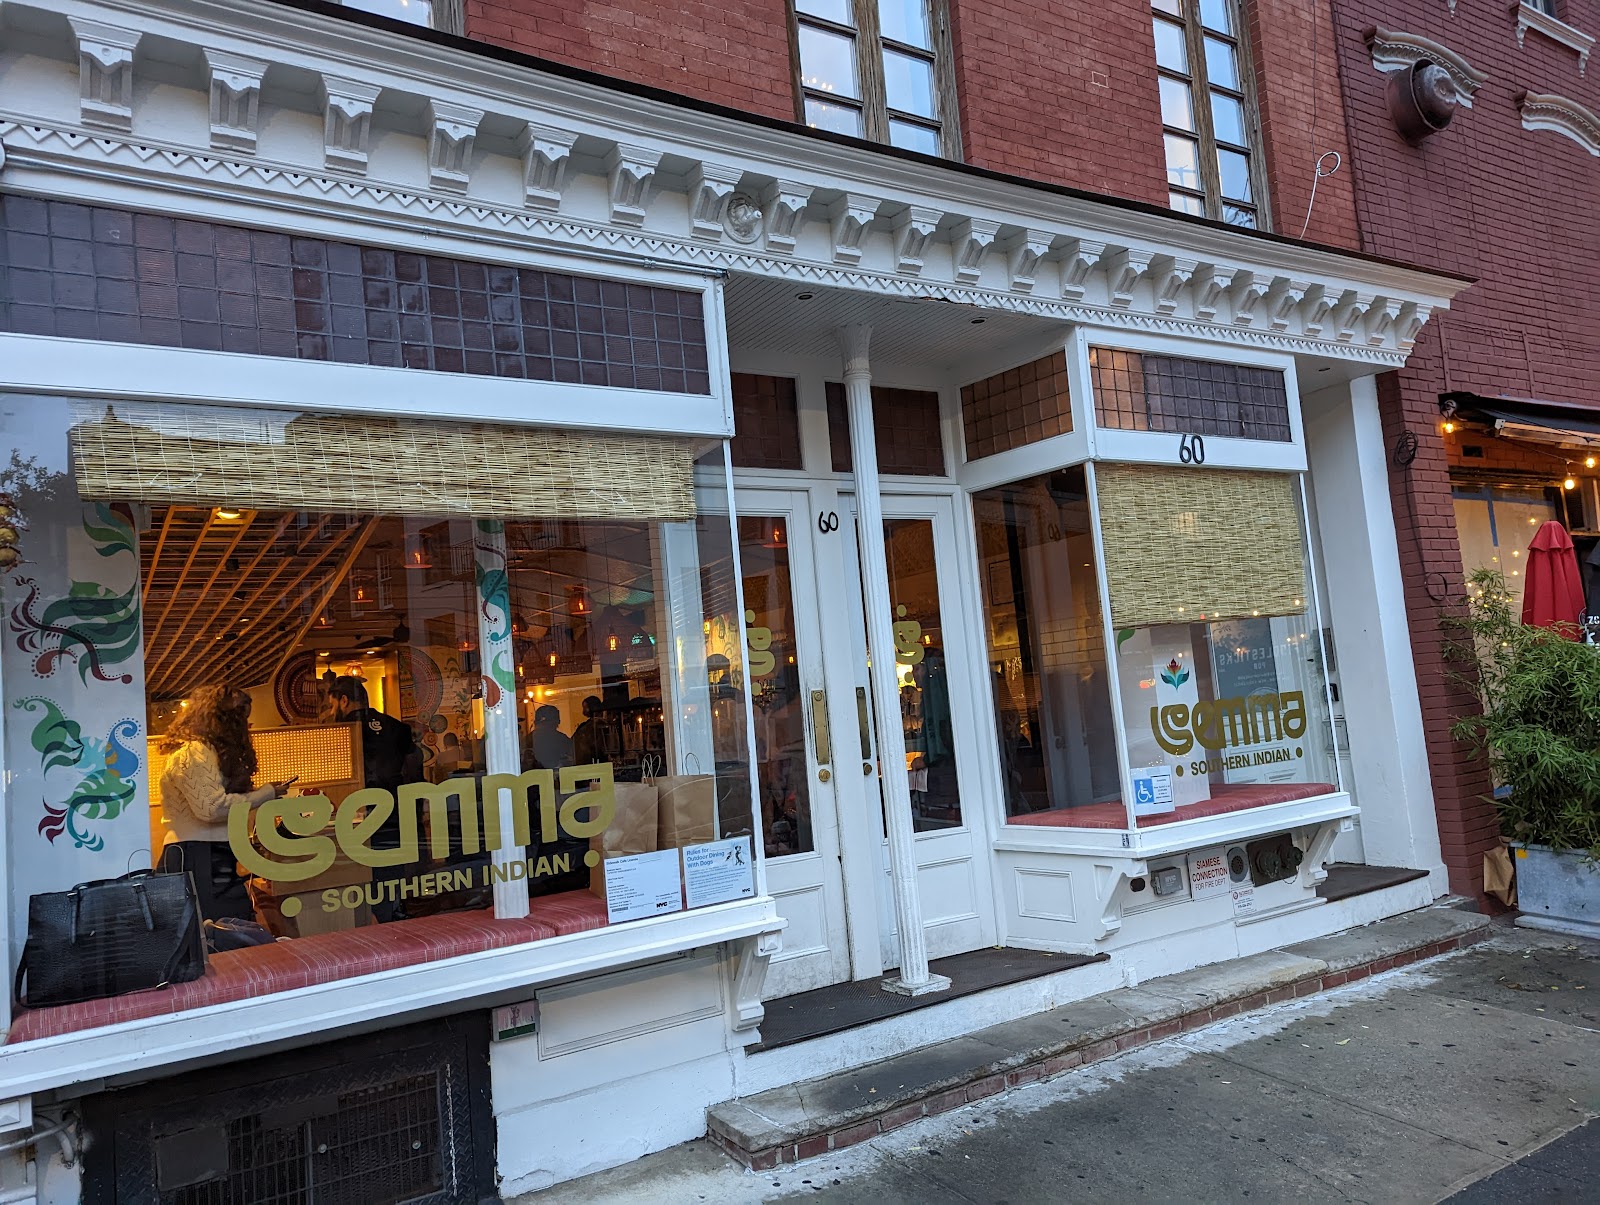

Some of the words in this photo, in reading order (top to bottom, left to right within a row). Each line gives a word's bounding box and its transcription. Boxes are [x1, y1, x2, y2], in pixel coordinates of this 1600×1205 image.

[1179, 433, 1205, 464] 60
[818, 511, 839, 533] 60
[1190, 756, 1250, 776] SOUTHERN
[1253, 747, 1291, 766] INDIAN
[686, 853, 709, 862] Outdoor
[708, 851, 725, 859] Dining
[700, 859, 714, 867] Dogs
[1196, 856, 1221, 870] SIAMESE
[1192, 866, 1228, 882] CONNECTION
[321, 867, 473, 913] SOUTHERN
[483, 852, 571, 886] INDIAN
[1195, 882, 1205, 891] FOR
[1205, 880, 1215, 889] FIRE
[1215, 877, 1226, 887] DEPT
[656, 901, 668, 909] NYC
